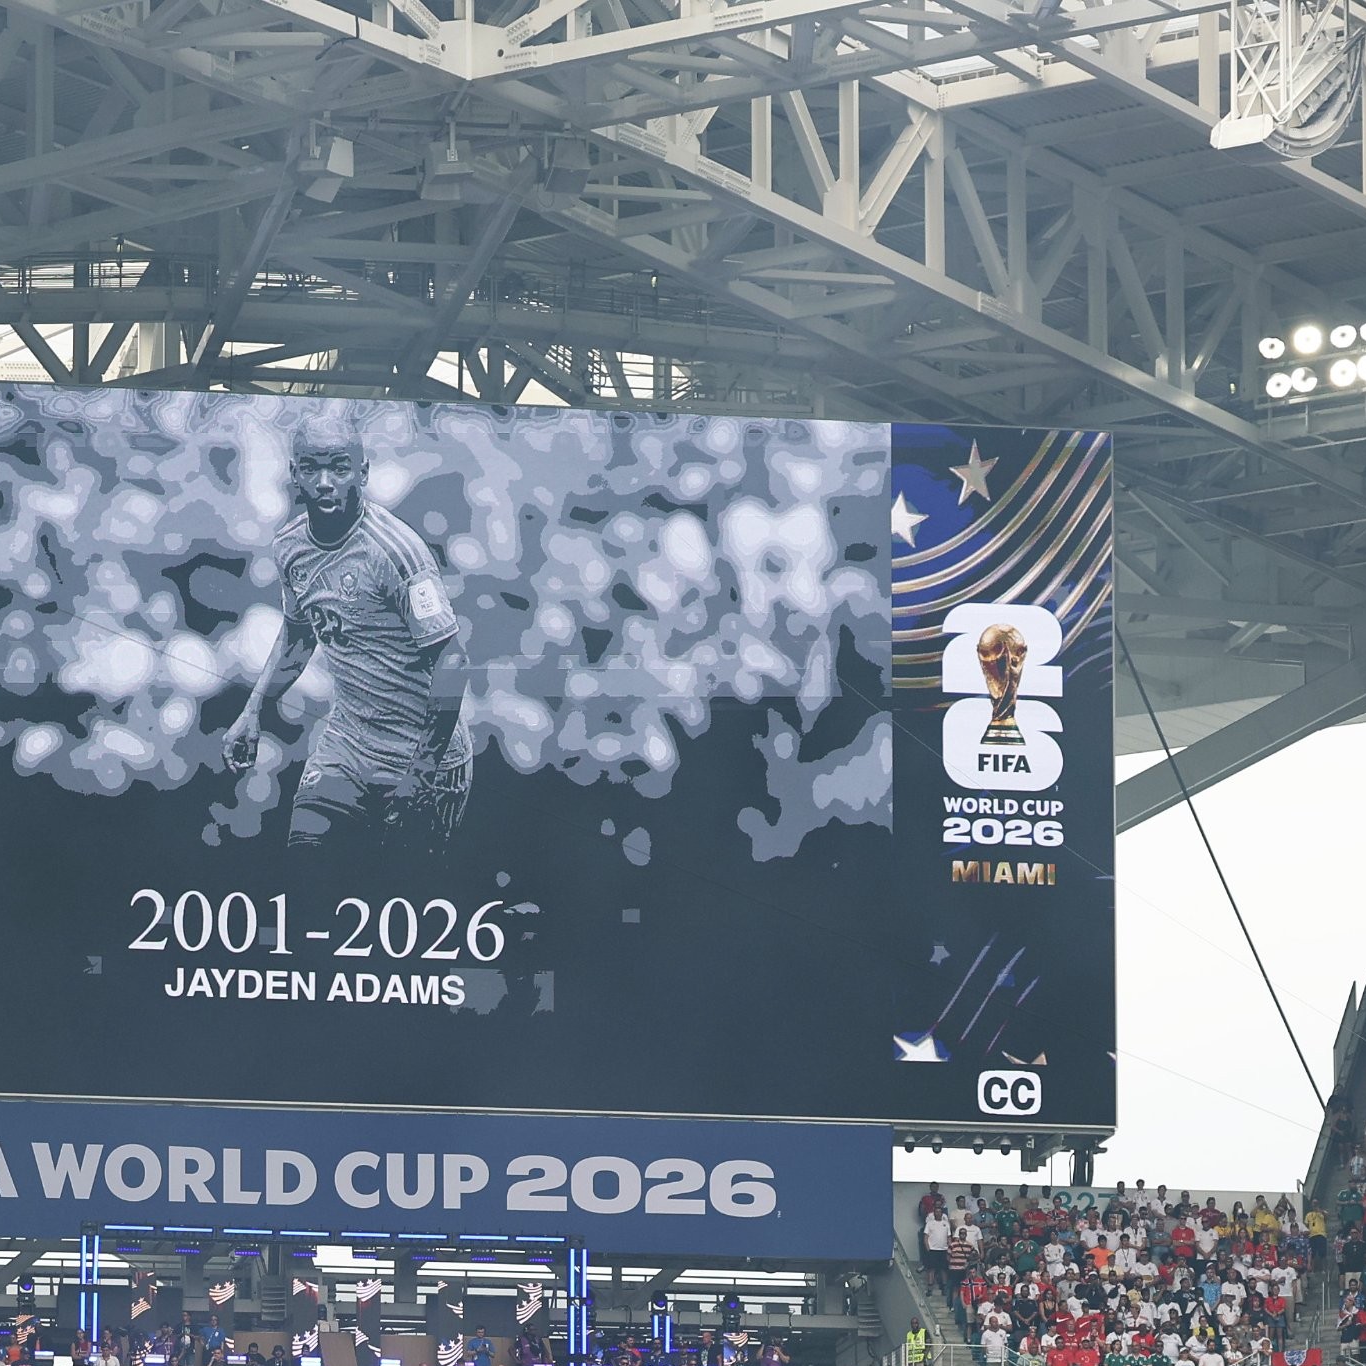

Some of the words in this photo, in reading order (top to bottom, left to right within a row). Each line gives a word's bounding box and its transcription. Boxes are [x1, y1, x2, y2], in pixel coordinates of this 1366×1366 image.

[978, 754, 1031, 774] FIFA
[943, 797, 1018, 815] WORLD
[1022, 800, 1063, 816] CUP
[943, 818, 1063, 846] 2026
[952, 861, 1056, 886] MIAMI
[129, 889, 505, 962] 2001-2026
[165, 968, 316, 1001] JAYDEN
[327, 973, 465, 1006] ADAMS
[984, 1076, 1035, 1110] CC
[31, 1143, 317, 1208] WORLD
[335, 1152, 490, 1209] CUP
[506, 1154, 777, 1218] 2026
